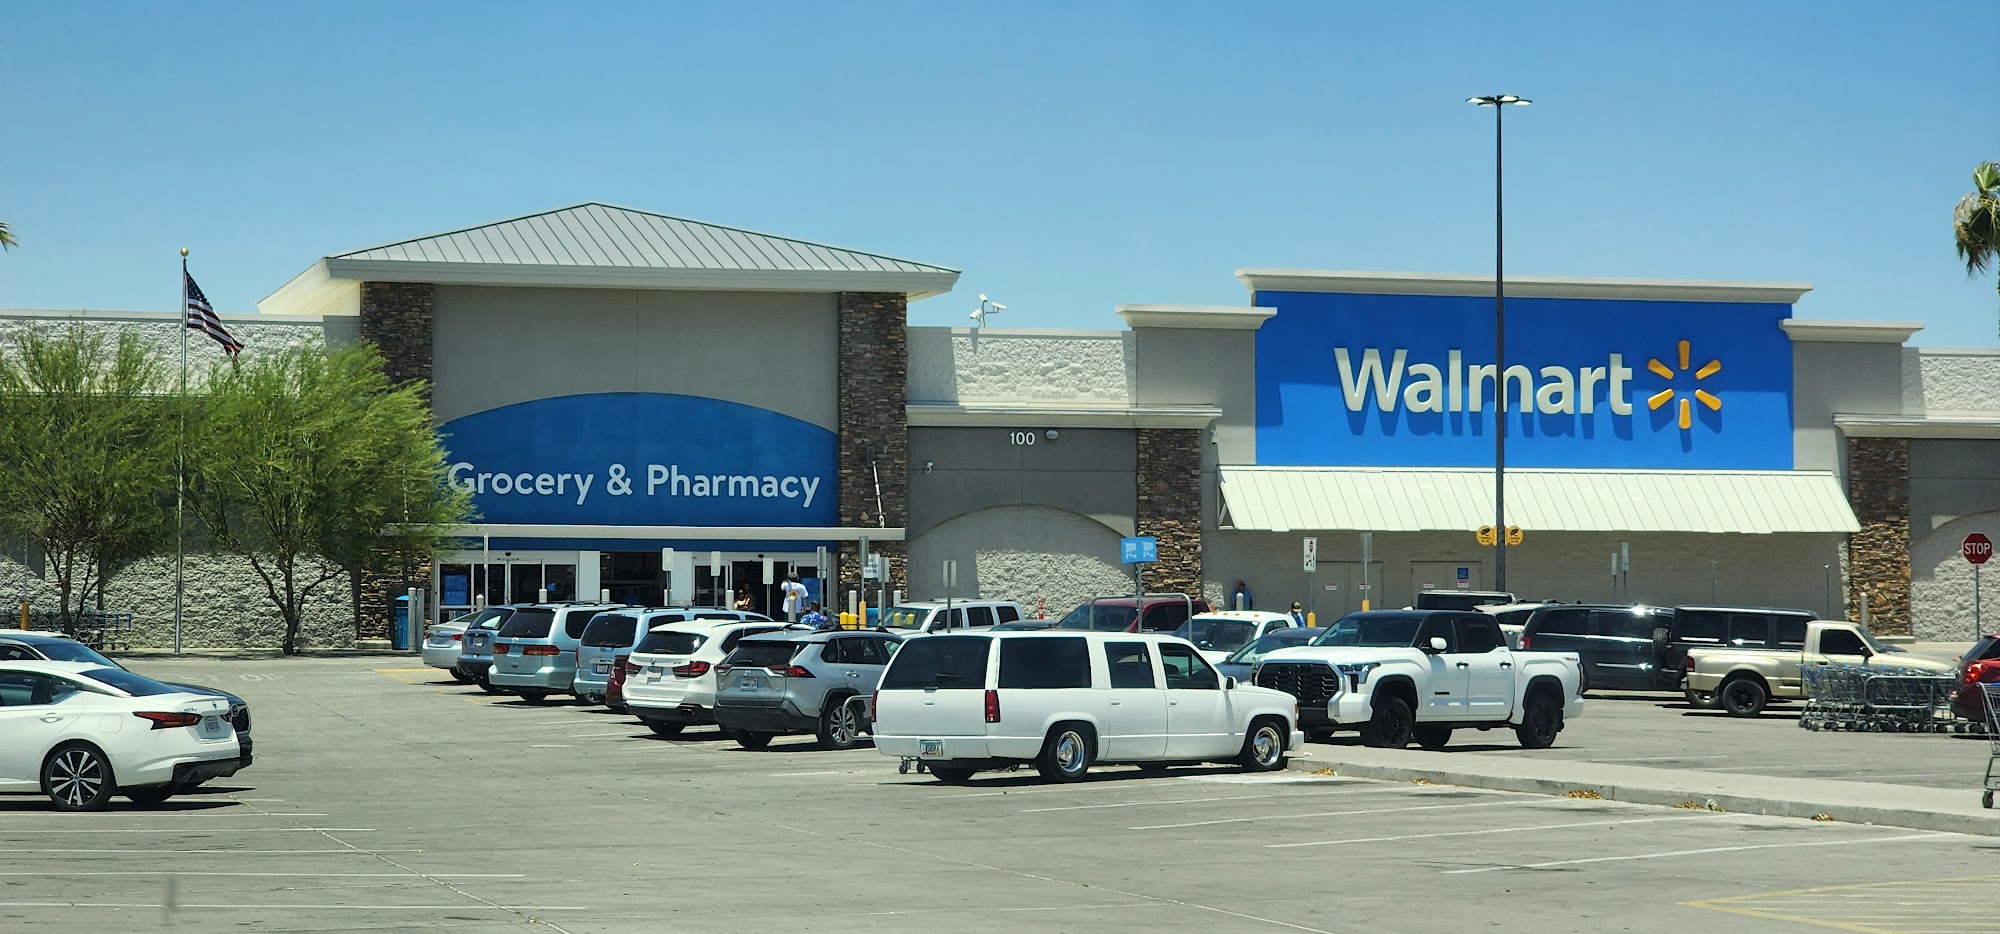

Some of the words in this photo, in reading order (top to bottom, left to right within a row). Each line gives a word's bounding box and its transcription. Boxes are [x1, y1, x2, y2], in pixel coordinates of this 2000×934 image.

[1333, 347, 1633, 416] Walmart
[1009, 431, 1035, 446] 100
[448, 462, 594, 506] Grocery
[605, 463, 633, 497] &
[647, 464, 821, 508] Pharmacy
[1964, 542, 1991, 555] STOP
